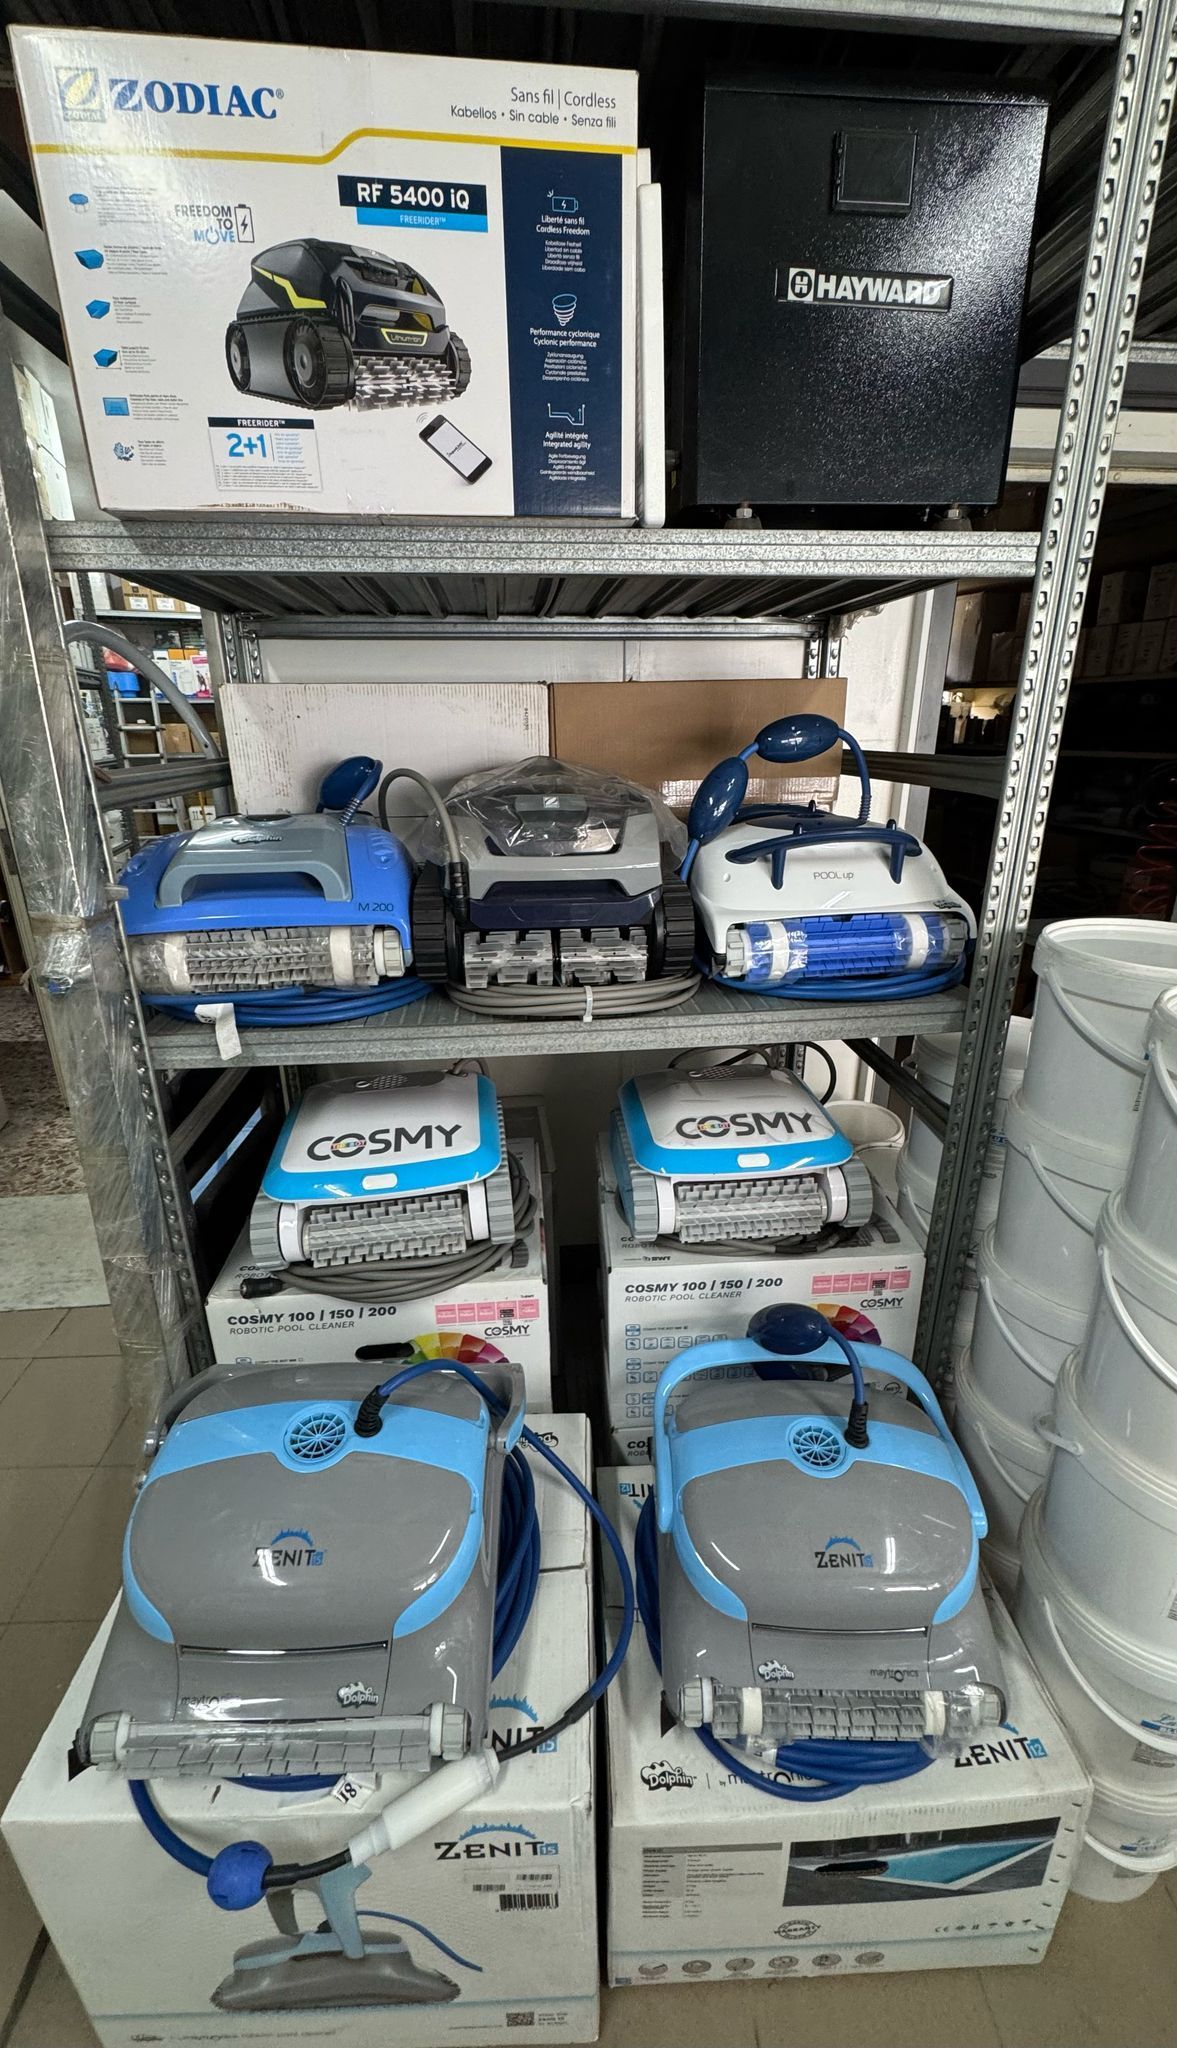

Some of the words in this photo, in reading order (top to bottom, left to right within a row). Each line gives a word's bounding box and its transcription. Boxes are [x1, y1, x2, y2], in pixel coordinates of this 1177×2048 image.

[511, 87, 540, 103] Sans
[543, 89, 554, 105] fil
[564, 91, 616, 109] Cordless
[450, 105, 497, 120] Kabellos
[509, 109, 525, 122] Sin
[528, 112, 560, 125] cable
[571, 114, 603, 128] Senza
[606, 116, 617, 129] fili
[357, 183, 383, 204] RF
[390, 185, 444, 208] 5400
[450, 189, 470, 210] iQ
[175, 204, 232, 218] FREEDOM
[217, 217, 233, 230] TO
[541, 214, 563, 224] Liberté
[536, 224, 562, 234] Cordless
[563, 226, 590, 236] Freedom
[817, 274, 944, 306] HAYWARD
[530, 328, 567, 337] Performance
[568, 330, 600, 340] cyclonique
[534, 337, 558, 346] Cyclonic
[559, 338, 597, 348] performance
[545, 432, 564, 440] Agilité
[564, 432, 588, 441] intégrée
[226, 432, 267, 458] 2+1
[543, 440, 572, 450] Integrated
[574, 442, 591, 450] agility
[358, 902, 370, 911] M
[372, 902, 394, 912] 200
[676, 1112, 813, 1140] COSMY
[307, 1124, 462, 1161] COSMY
[625, 1282, 679, 1294] COSMY
[682, 1281, 706, 1292] 100
[720, 1279, 743, 1290] 150
[756, 1277, 783, 1288] 200
[625, 1294, 667, 1302] ROBOTIC
[670, 1293, 696, 1301] POOL
[699, 1291, 742, 1300] CLEANER
[860, 1297, 904, 1308] COSMY
[227, 1314, 284, 1326] COSMY
[288, 1312, 315, 1322] 100
[330, 1309, 354, 1320] 150
[368, 1306, 397, 1317] 200
[230, 1326, 274, 1334] ROBOTIC
[277, 1324, 305, 1332] POOL
[309, 1321, 355, 1331] CLEANER
[484, 1325, 530, 1336] COSMY
[814, 1552, 864, 1568] ZENIT
[764, 1668, 795, 1681] Dolphin
[342, 1691, 379, 1708] Dolphin
[1028, 1740, 1046, 1758] 12
[434, 1841, 544, 1860] ZENIT
